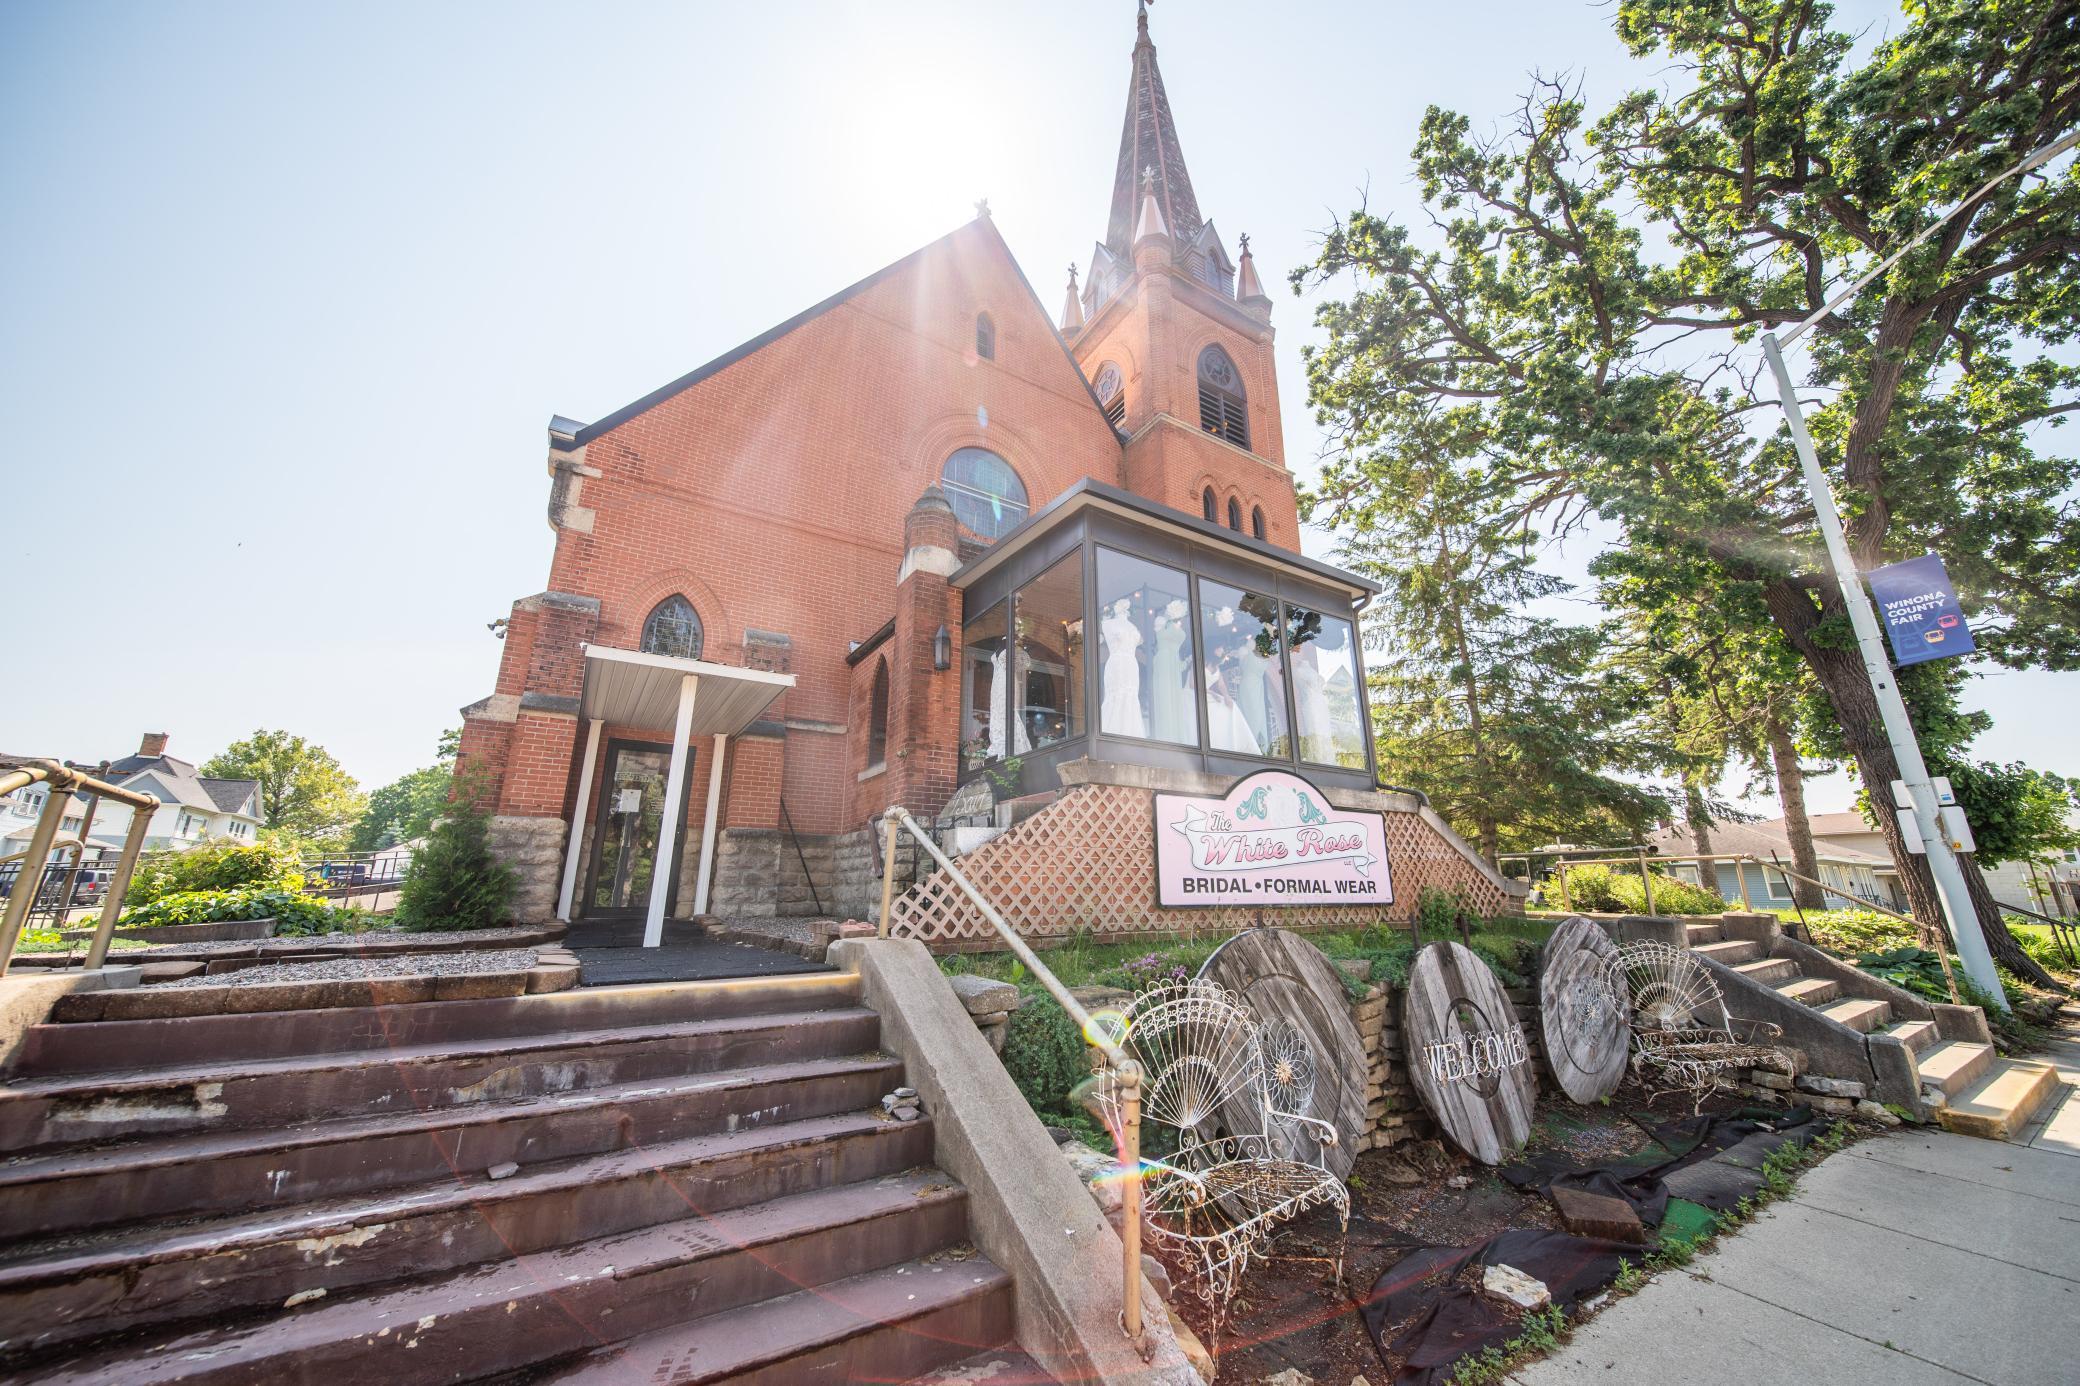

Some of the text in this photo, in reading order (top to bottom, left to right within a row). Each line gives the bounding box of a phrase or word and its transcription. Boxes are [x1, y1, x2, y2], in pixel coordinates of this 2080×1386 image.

[1884, 591, 1947, 610] WINONA
[1887, 599, 1945, 618] COUNTY
[1890, 613, 1924, 626] FAIR
[1210, 810, 1233, 831] The
[1201, 827, 1363, 866] White Rose
[1182, 877, 1377, 894] BRIDAL FORMAL WEAR
[1422, 1024, 1528, 1083] WELCOME
